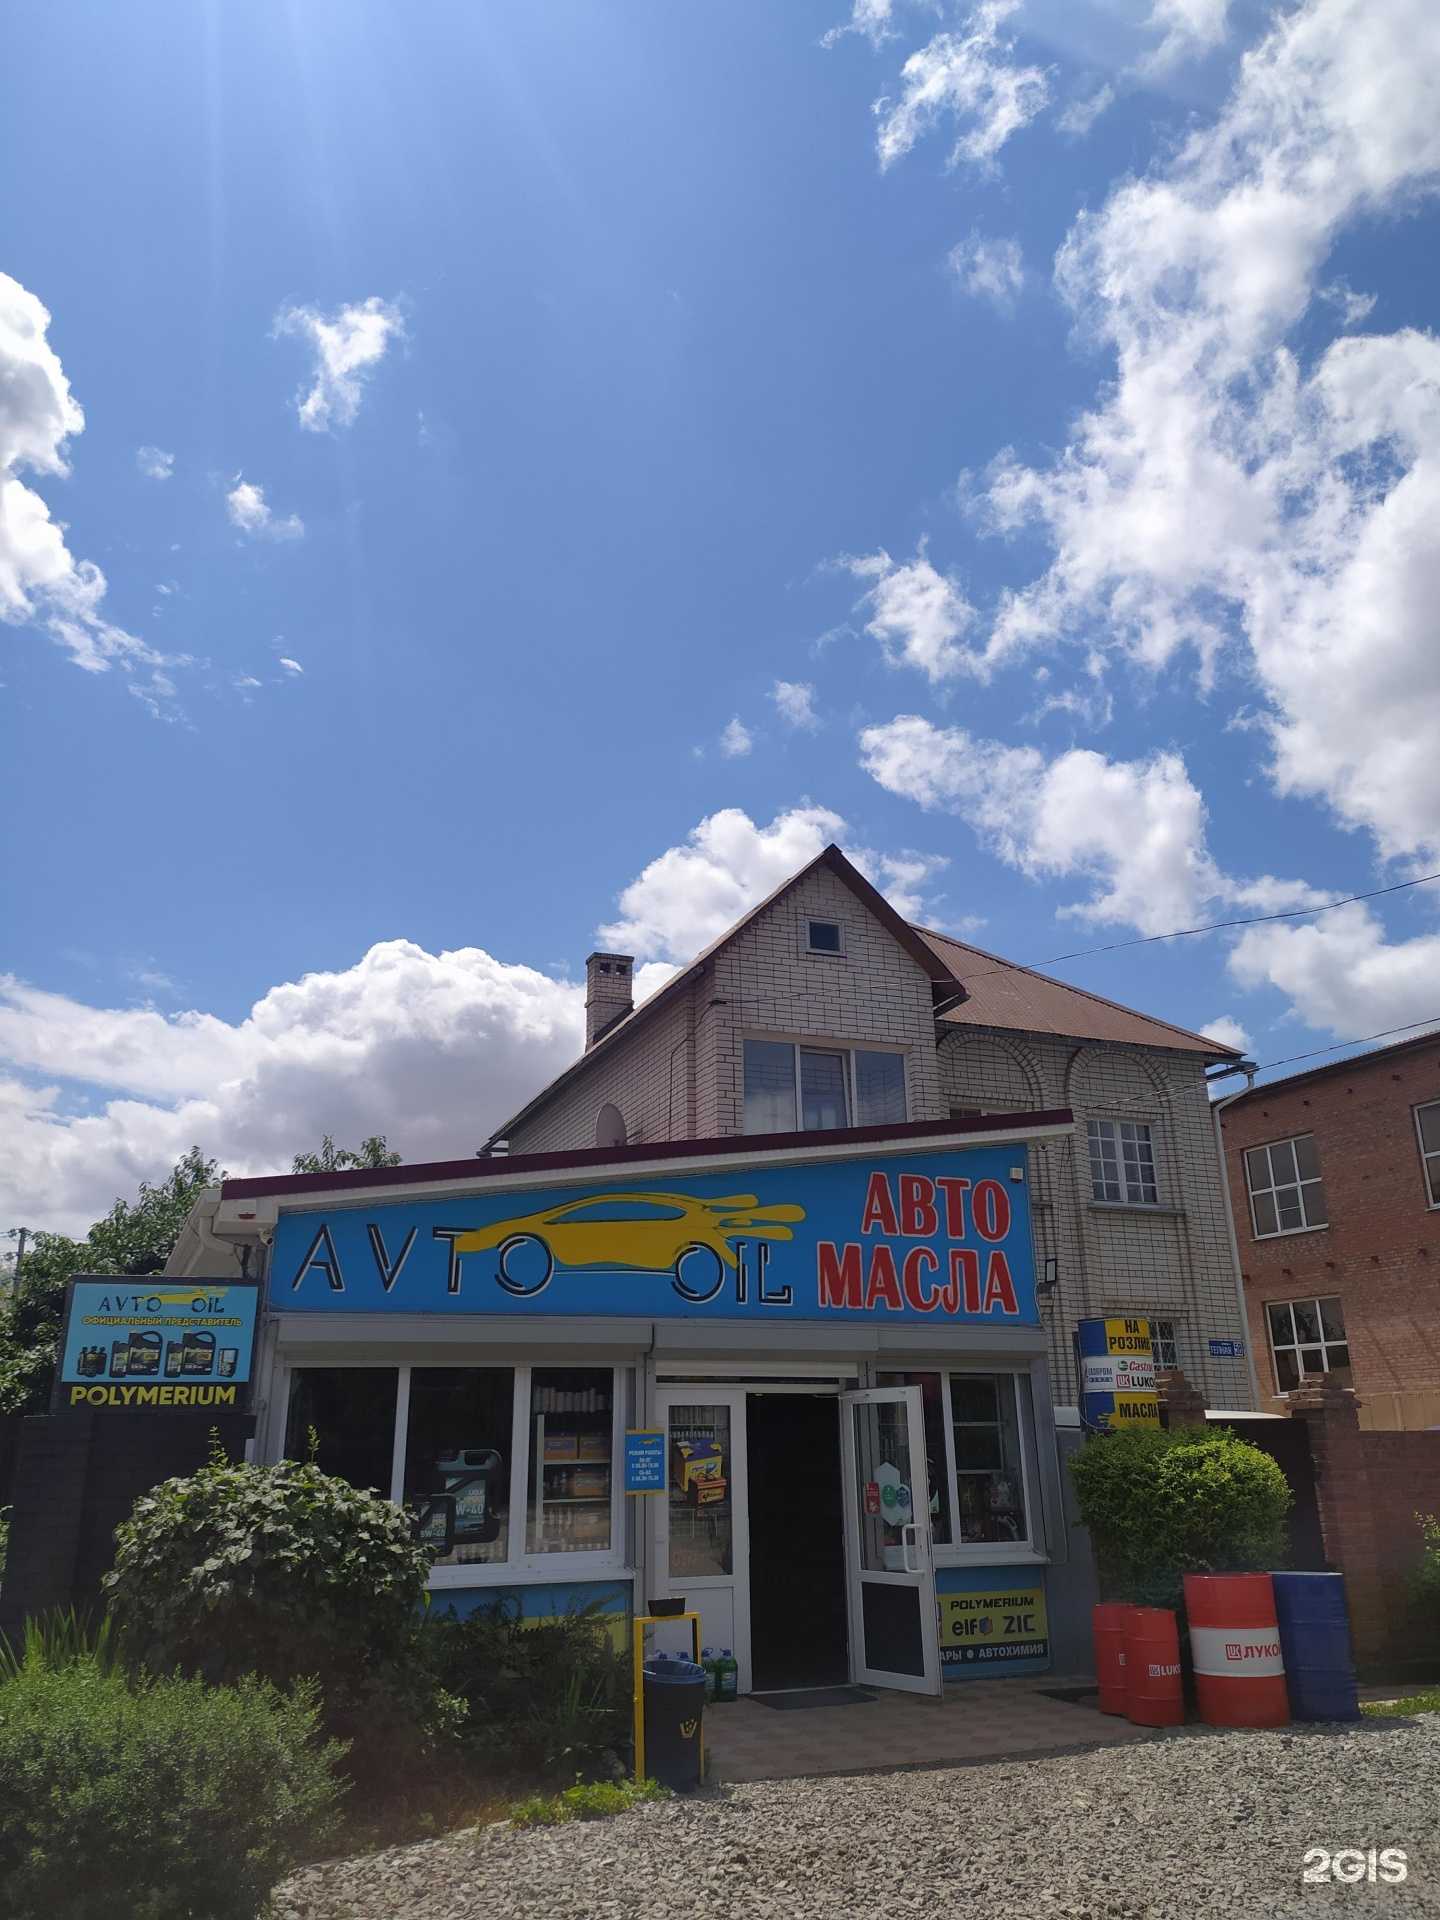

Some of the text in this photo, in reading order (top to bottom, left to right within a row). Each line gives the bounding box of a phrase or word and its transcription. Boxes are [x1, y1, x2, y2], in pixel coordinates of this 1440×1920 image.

[862, 1171, 1012, 1243] АВТО
[292, 1223, 794, 1306] AVTO OIL
[816, 1241, 1021, 1316] МАСЛА
[97, 1295, 226, 1313] AVTO OIL
[81, 1315, 242, 1327] ОФИЦИАЛЬНЫЙ ПРЕДСТАВИТЕЛЬ
[1124, 1319, 1140, 1334] НА
[70, 1385, 237, 1406] POLYMERIUM
[950, 1596, 1034, 1611] POLYMERIUM
[951, 1614, 1036, 1636] elf ZIC
[978, 1643, 1044, 1659] АВТОХИМИЯ
